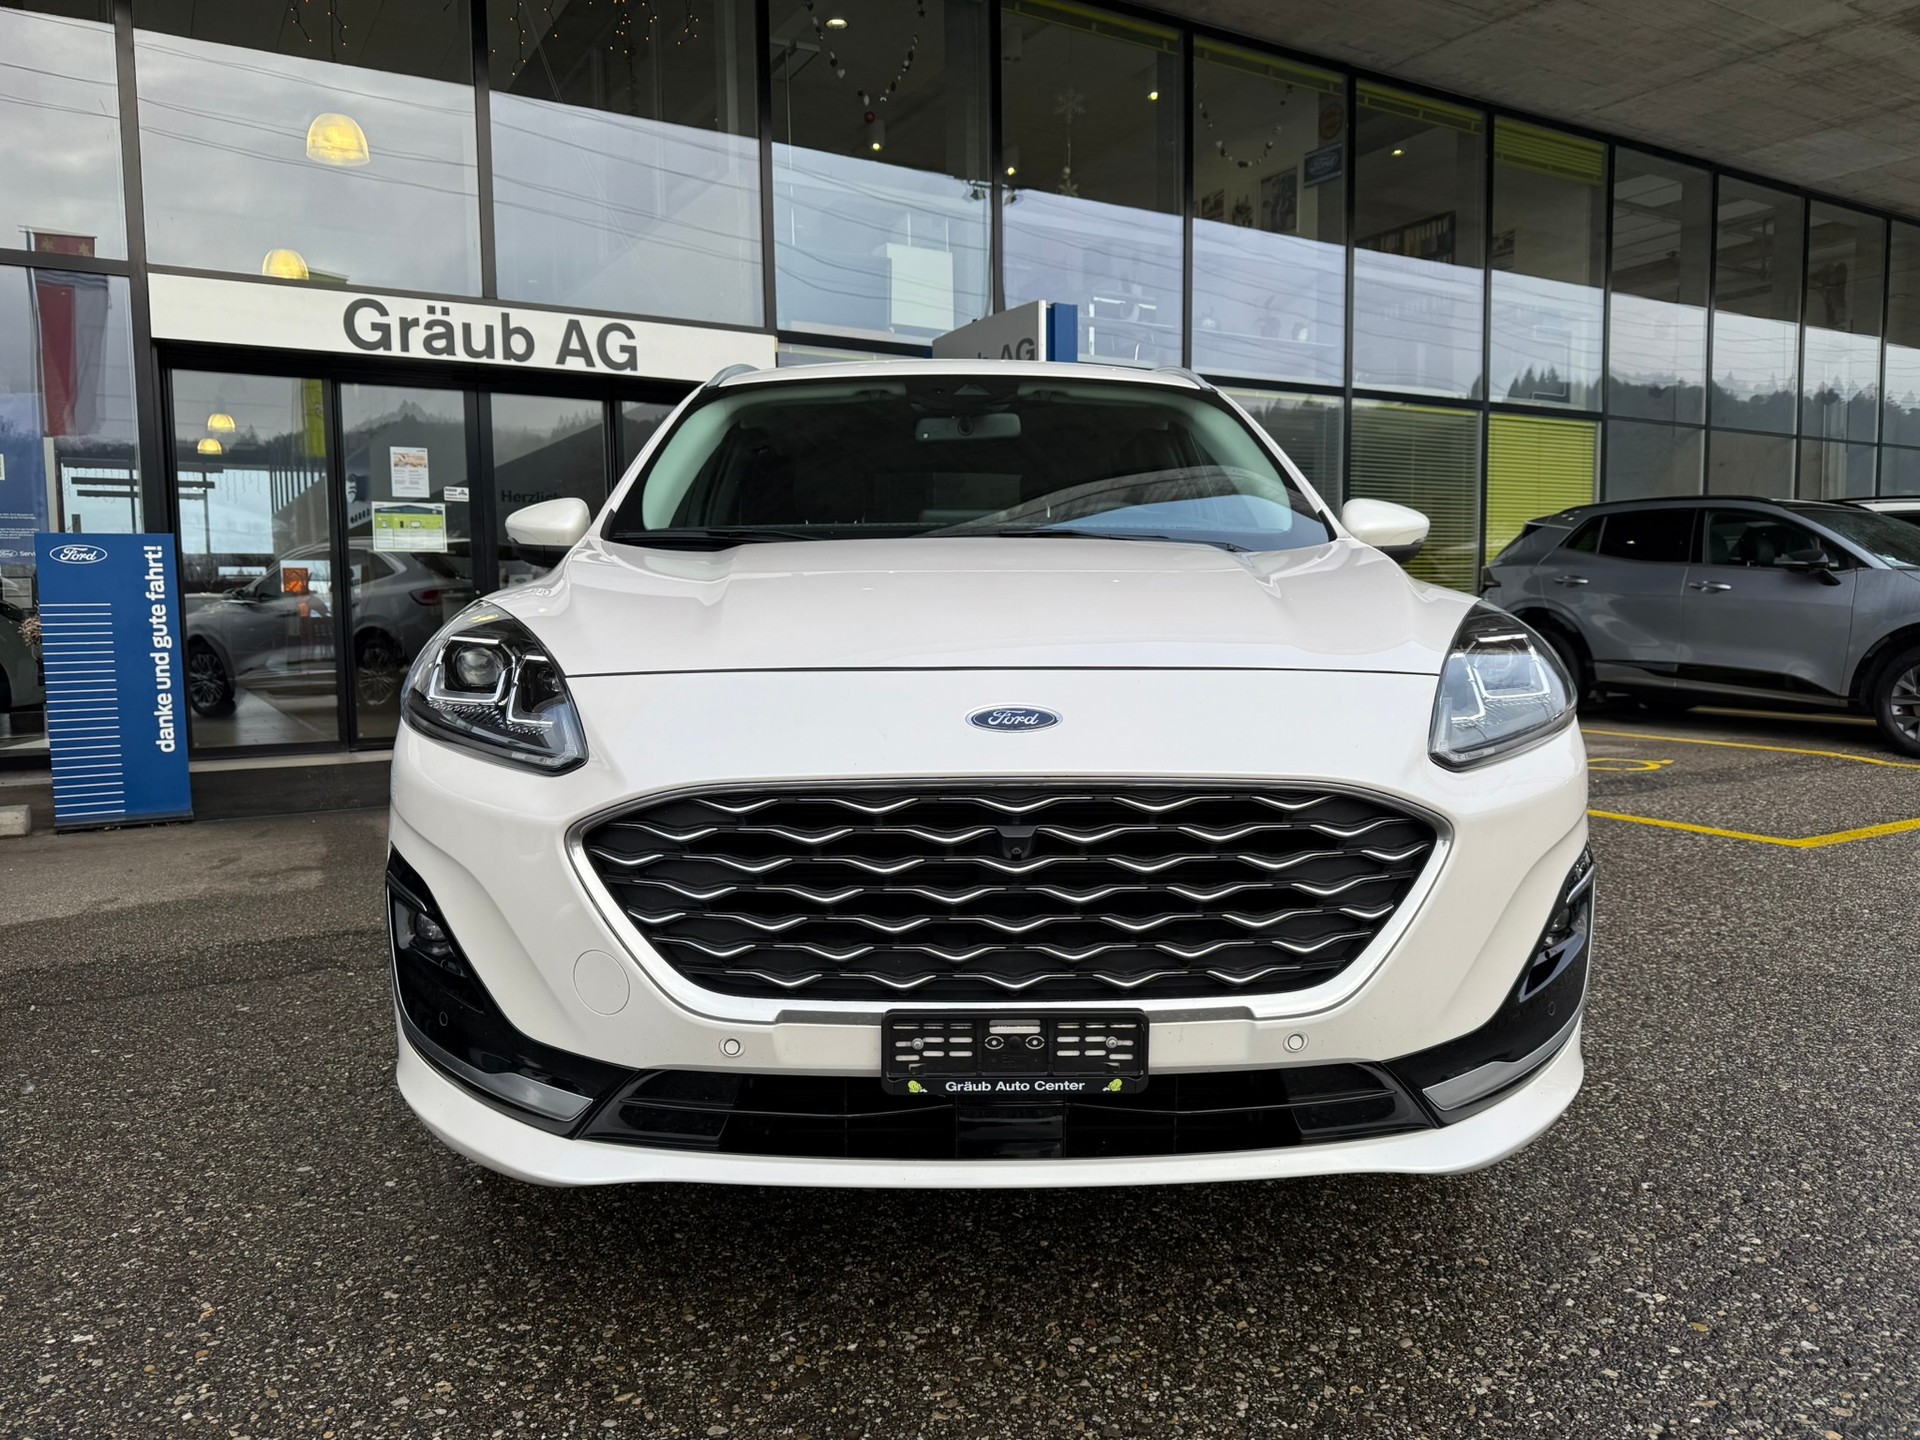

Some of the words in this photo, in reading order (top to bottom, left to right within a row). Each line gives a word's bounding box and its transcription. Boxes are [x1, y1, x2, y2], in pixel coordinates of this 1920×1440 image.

[343, 298, 535, 363] Gräub
[555, 318, 638, 372] AG
[60, 547, 97, 561] Ford
[143, 545, 166, 601] fahrt!
[148, 604, 173, 649] gute
[149, 652, 171, 690] und
[153, 693, 176, 753] danke
[988, 710, 1040, 725] Ford
[945, 1080, 991, 1091] Gräub
[997, 1081, 1031, 1091] Auto
[1034, 1080, 1086, 1091] Center
